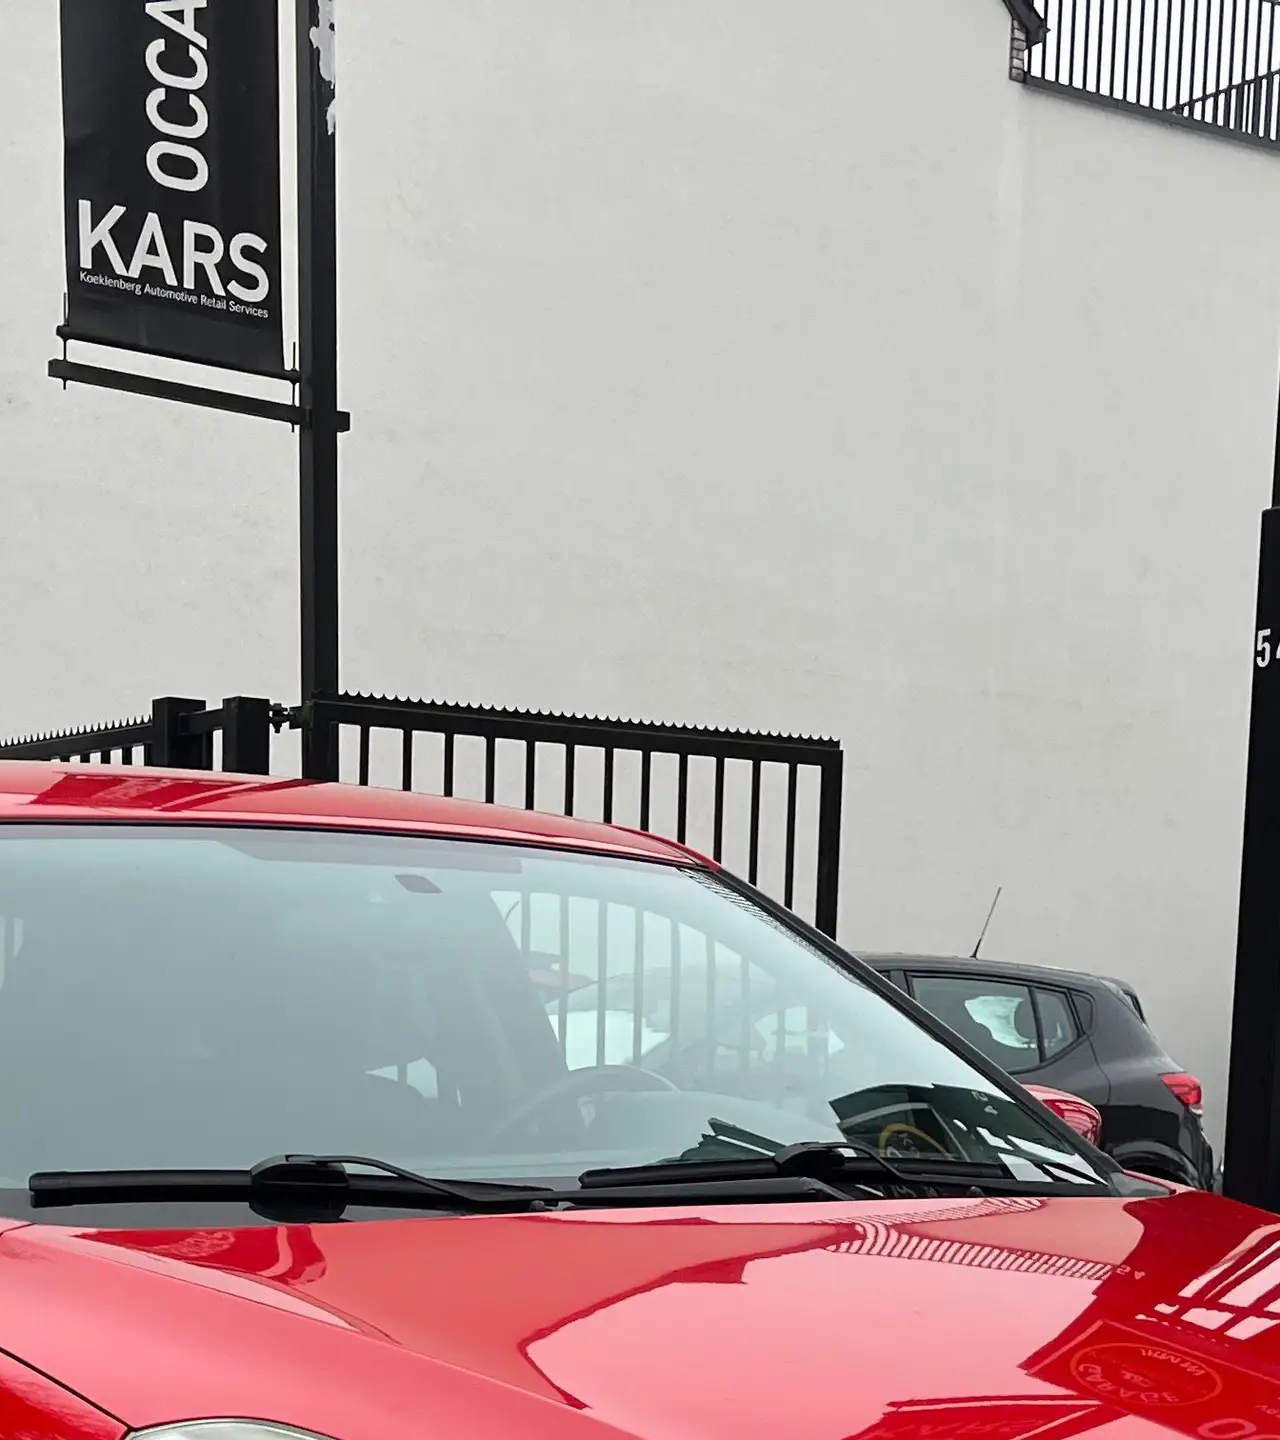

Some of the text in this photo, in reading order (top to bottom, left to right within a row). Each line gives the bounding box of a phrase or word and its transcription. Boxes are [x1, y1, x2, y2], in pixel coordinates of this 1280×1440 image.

[78, 199, 269, 303] KARS
[79, 271, 269, 318] Koeklenberg Automotive Retail Services
